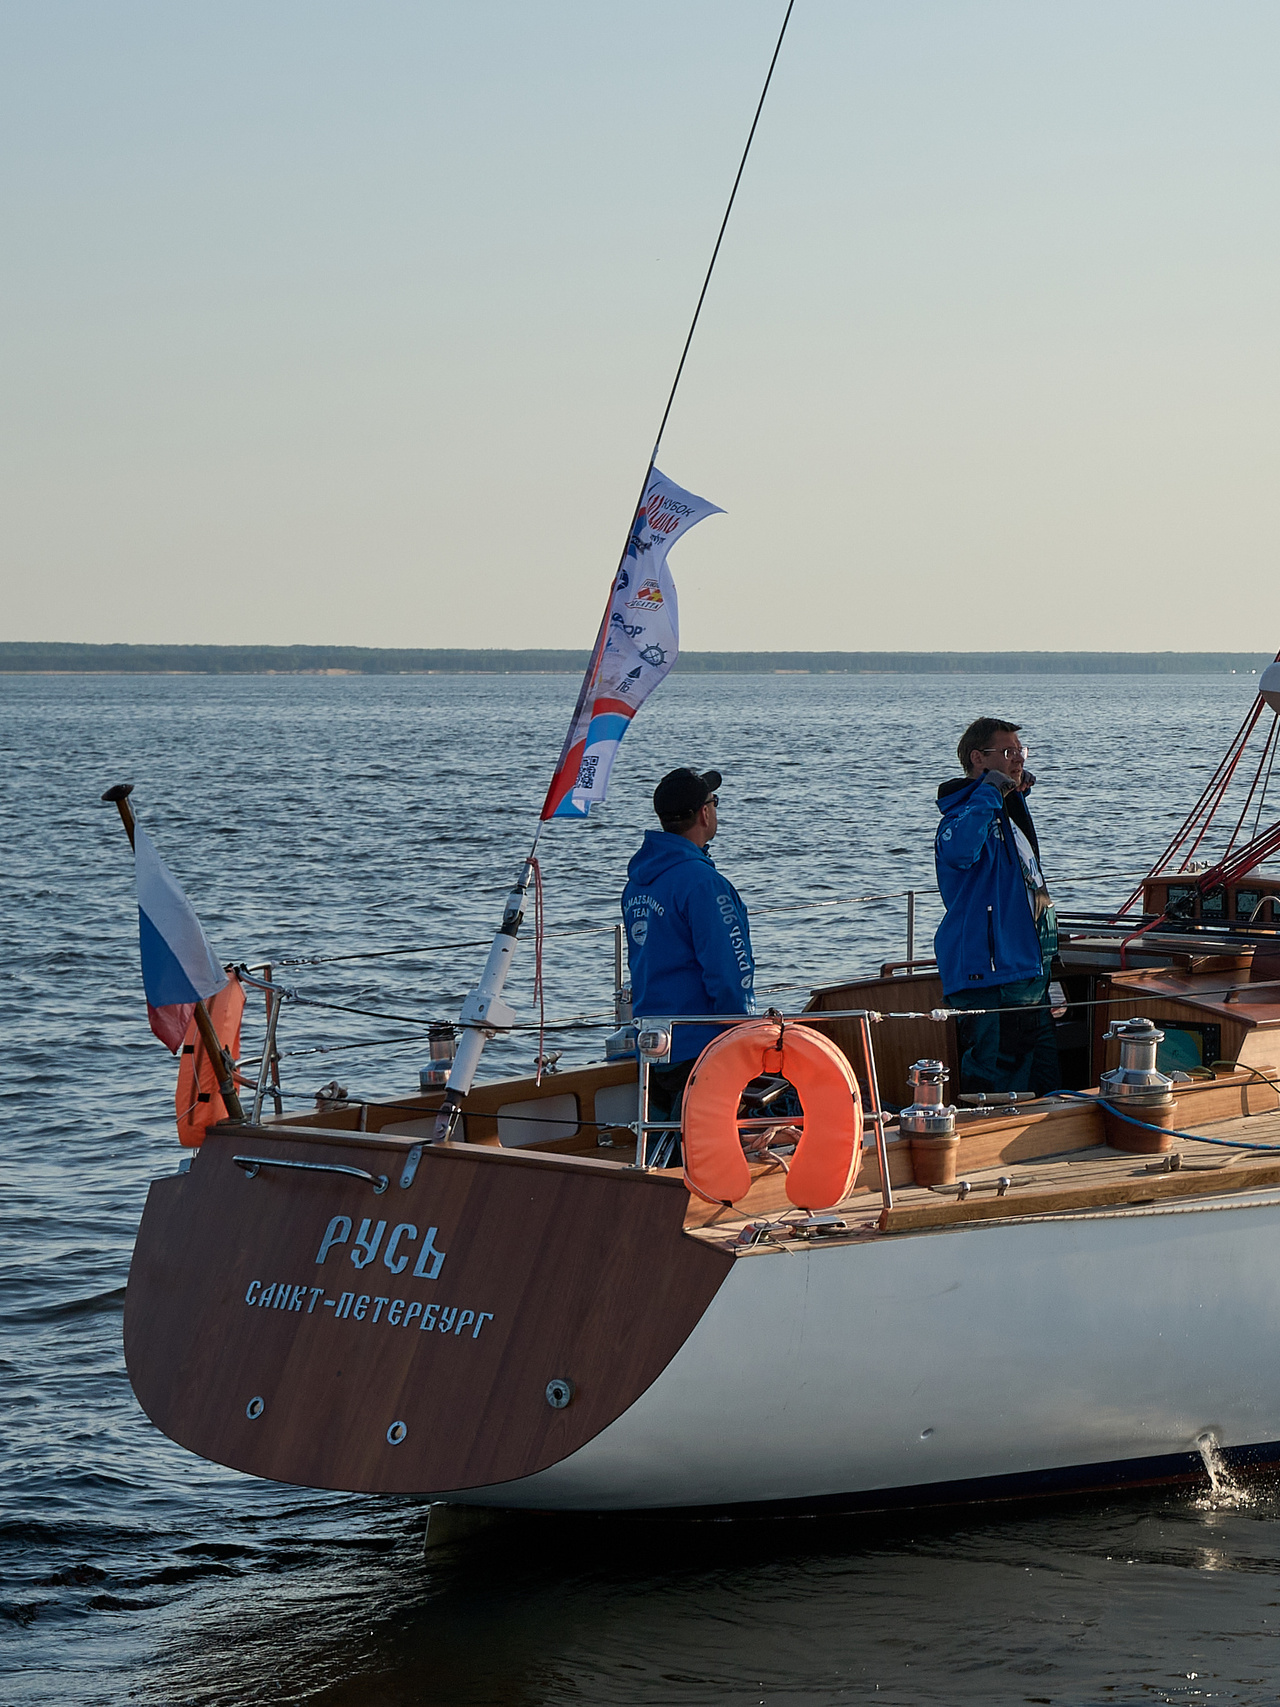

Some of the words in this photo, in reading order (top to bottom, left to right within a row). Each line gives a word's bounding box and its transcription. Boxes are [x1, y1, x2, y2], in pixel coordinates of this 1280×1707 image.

[661, 498, 696, 517] КУБОК
[315, 1215, 446, 1280] РУСЬ
[245, 1279, 494, 1339] САНКТ-ПЕТЕРБУРГ
